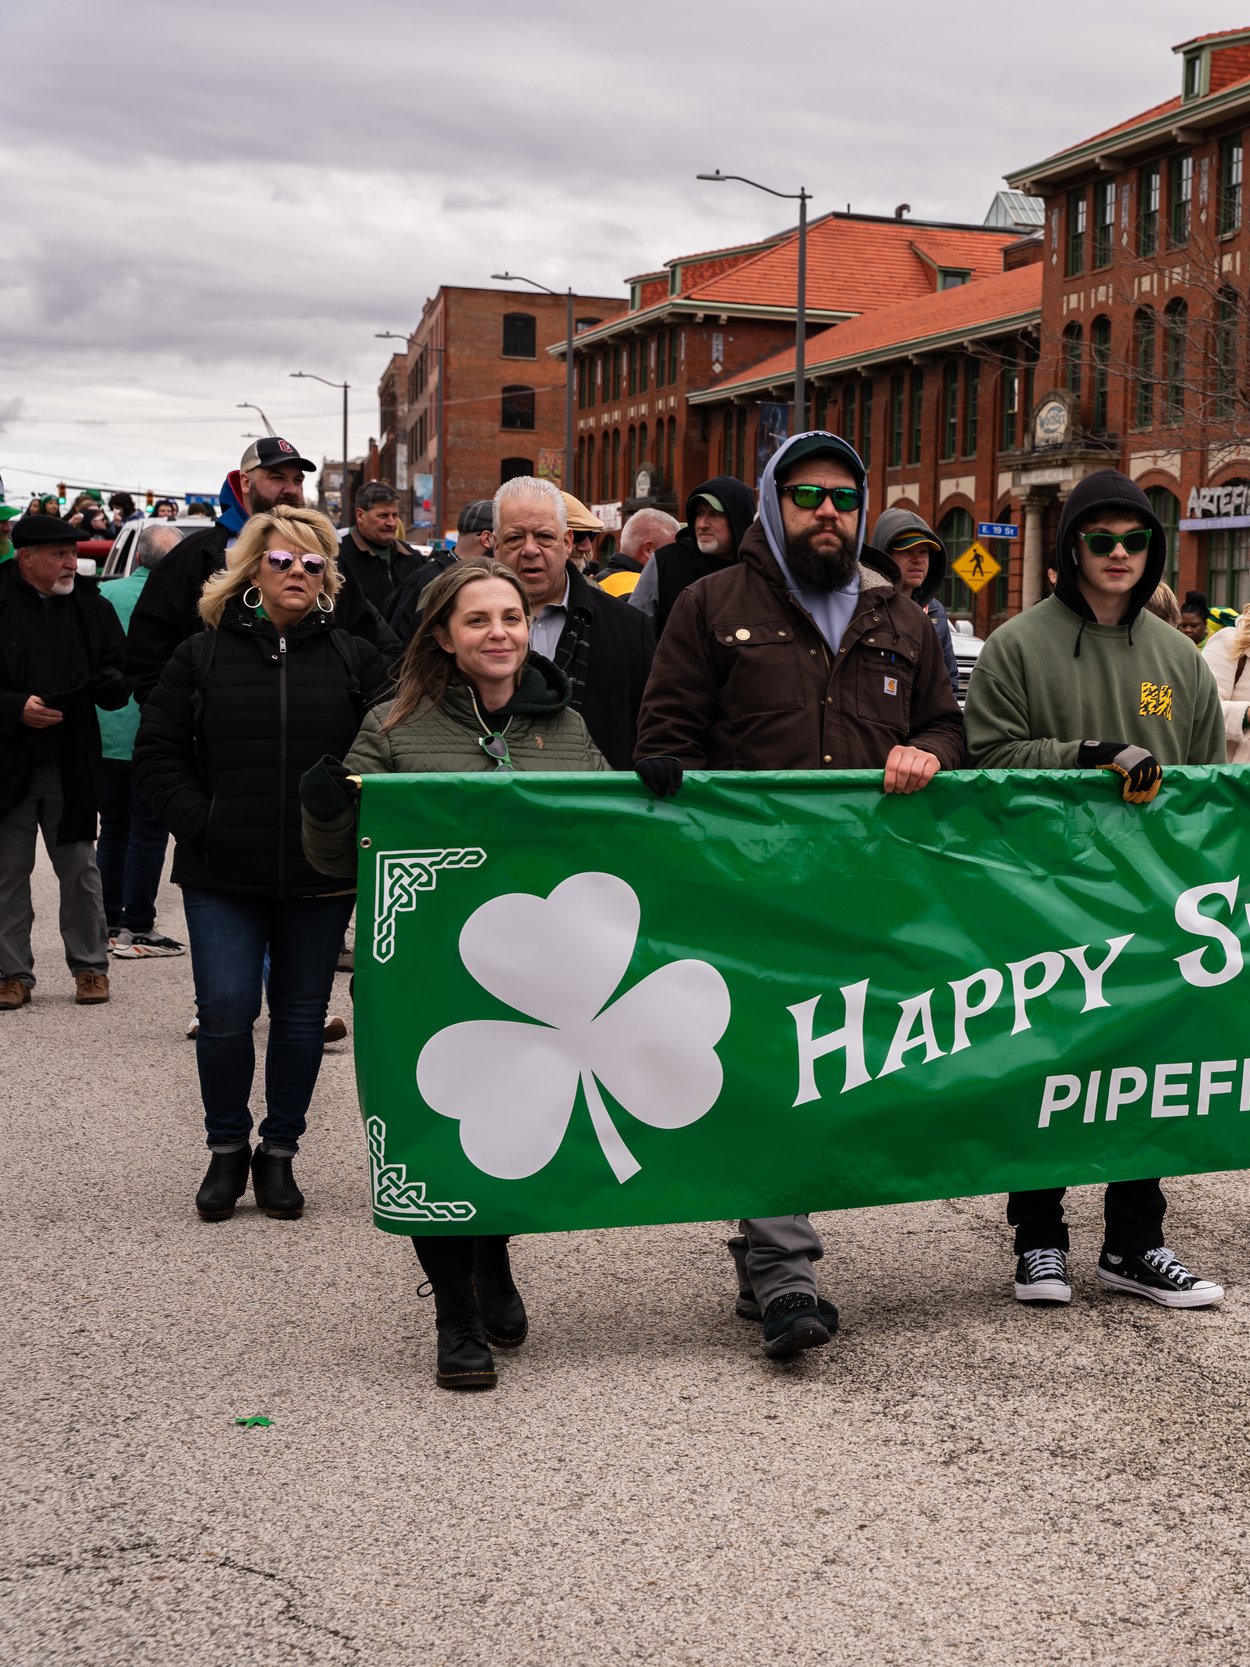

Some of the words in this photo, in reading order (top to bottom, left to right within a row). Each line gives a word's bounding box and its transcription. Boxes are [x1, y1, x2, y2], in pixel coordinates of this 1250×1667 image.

[992, 526, 1002, 535] 19
[1004, 527, 1014, 536] St
[786, 931, 1136, 1108] HAPPY
